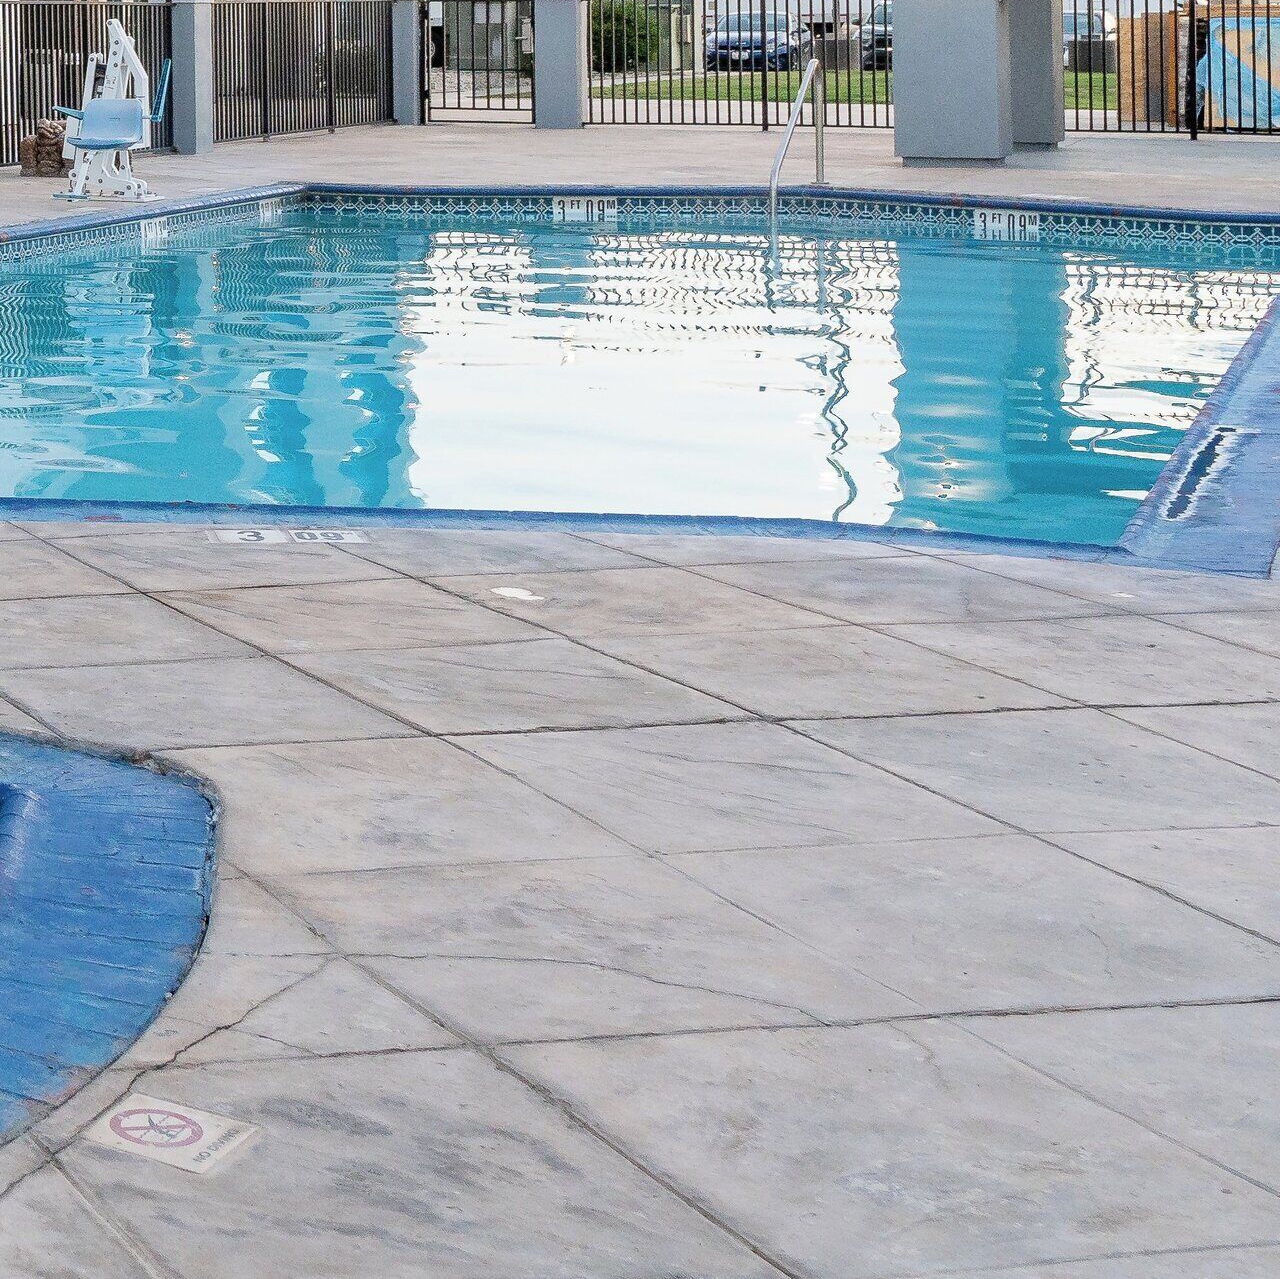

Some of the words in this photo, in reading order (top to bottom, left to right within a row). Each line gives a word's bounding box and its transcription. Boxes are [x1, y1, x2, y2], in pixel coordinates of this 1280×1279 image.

[992, 213, 1001, 223] FT
[237, 530, 265, 541] 3
[193, 1151, 211, 1162] NO
